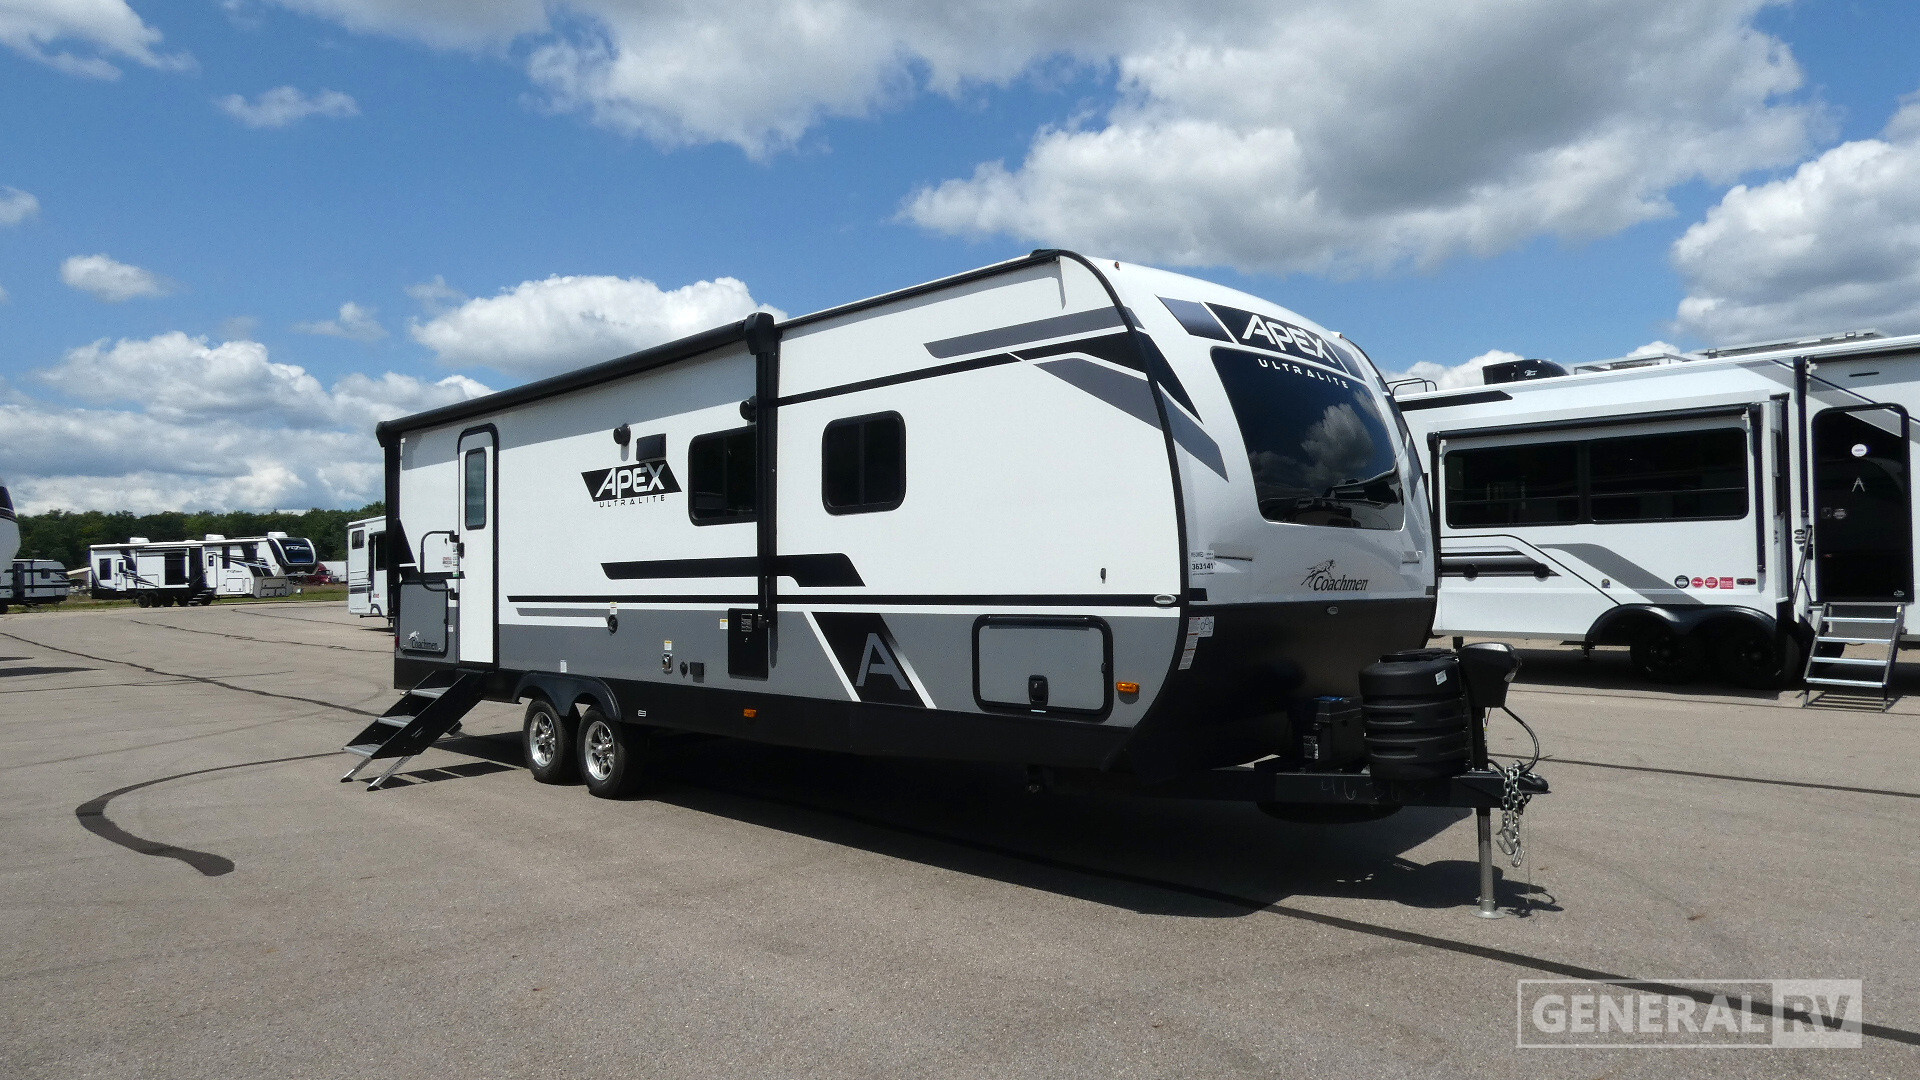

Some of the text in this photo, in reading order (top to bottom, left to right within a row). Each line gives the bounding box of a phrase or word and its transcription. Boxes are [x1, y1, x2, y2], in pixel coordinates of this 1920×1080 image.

[1241, 314, 1336, 364] APEX
[1257, 358, 1349, 389] ULTRALITE
[595, 462, 665, 498] APEX
[599, 495, 665, 508] ULTRALITE
[1313, 574, 1369, 591] Coachmen
[855, 632, 911, 691] A
